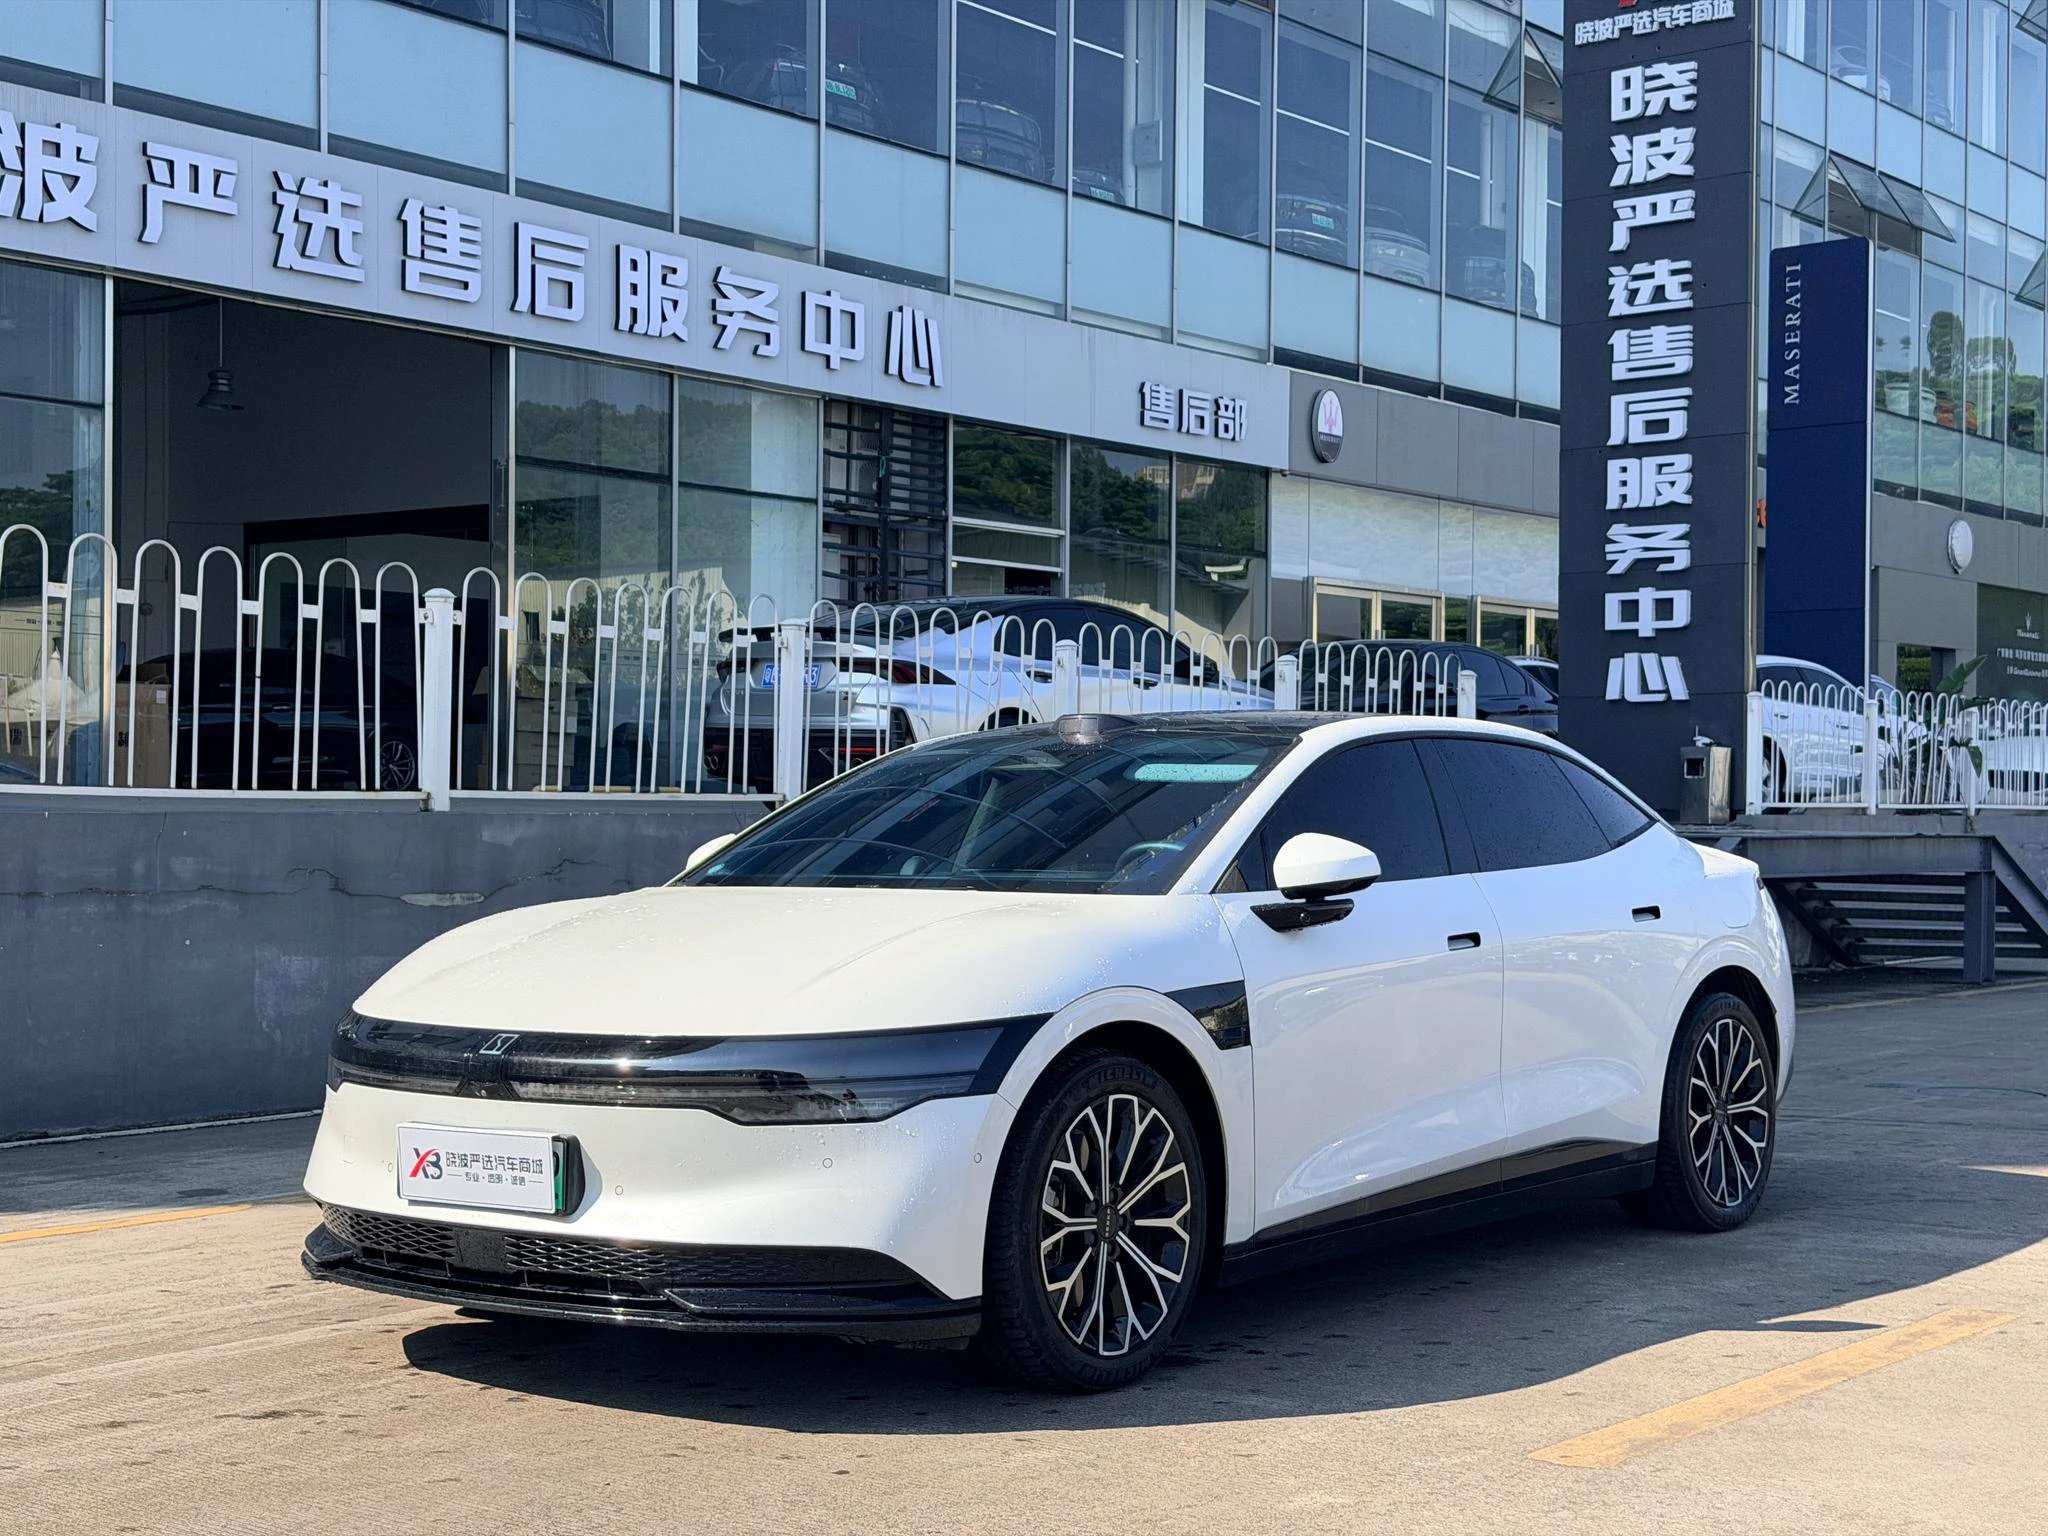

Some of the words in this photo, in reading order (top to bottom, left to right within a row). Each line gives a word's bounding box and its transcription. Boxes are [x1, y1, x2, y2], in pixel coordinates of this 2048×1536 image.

[1574, 0, 1735, 46] 晓波严选汽车商城
[0, 109, 943, 388] 波严选售后服务中心
[1604, 60, 1699, 703] 晓波严选售后服务中心
[1784, 263, 1802, 405] MASERATI
[1140, 381, 1248, 442] 售后部
[445, 1151, 543, 1174] 晓波严选汽车商城
